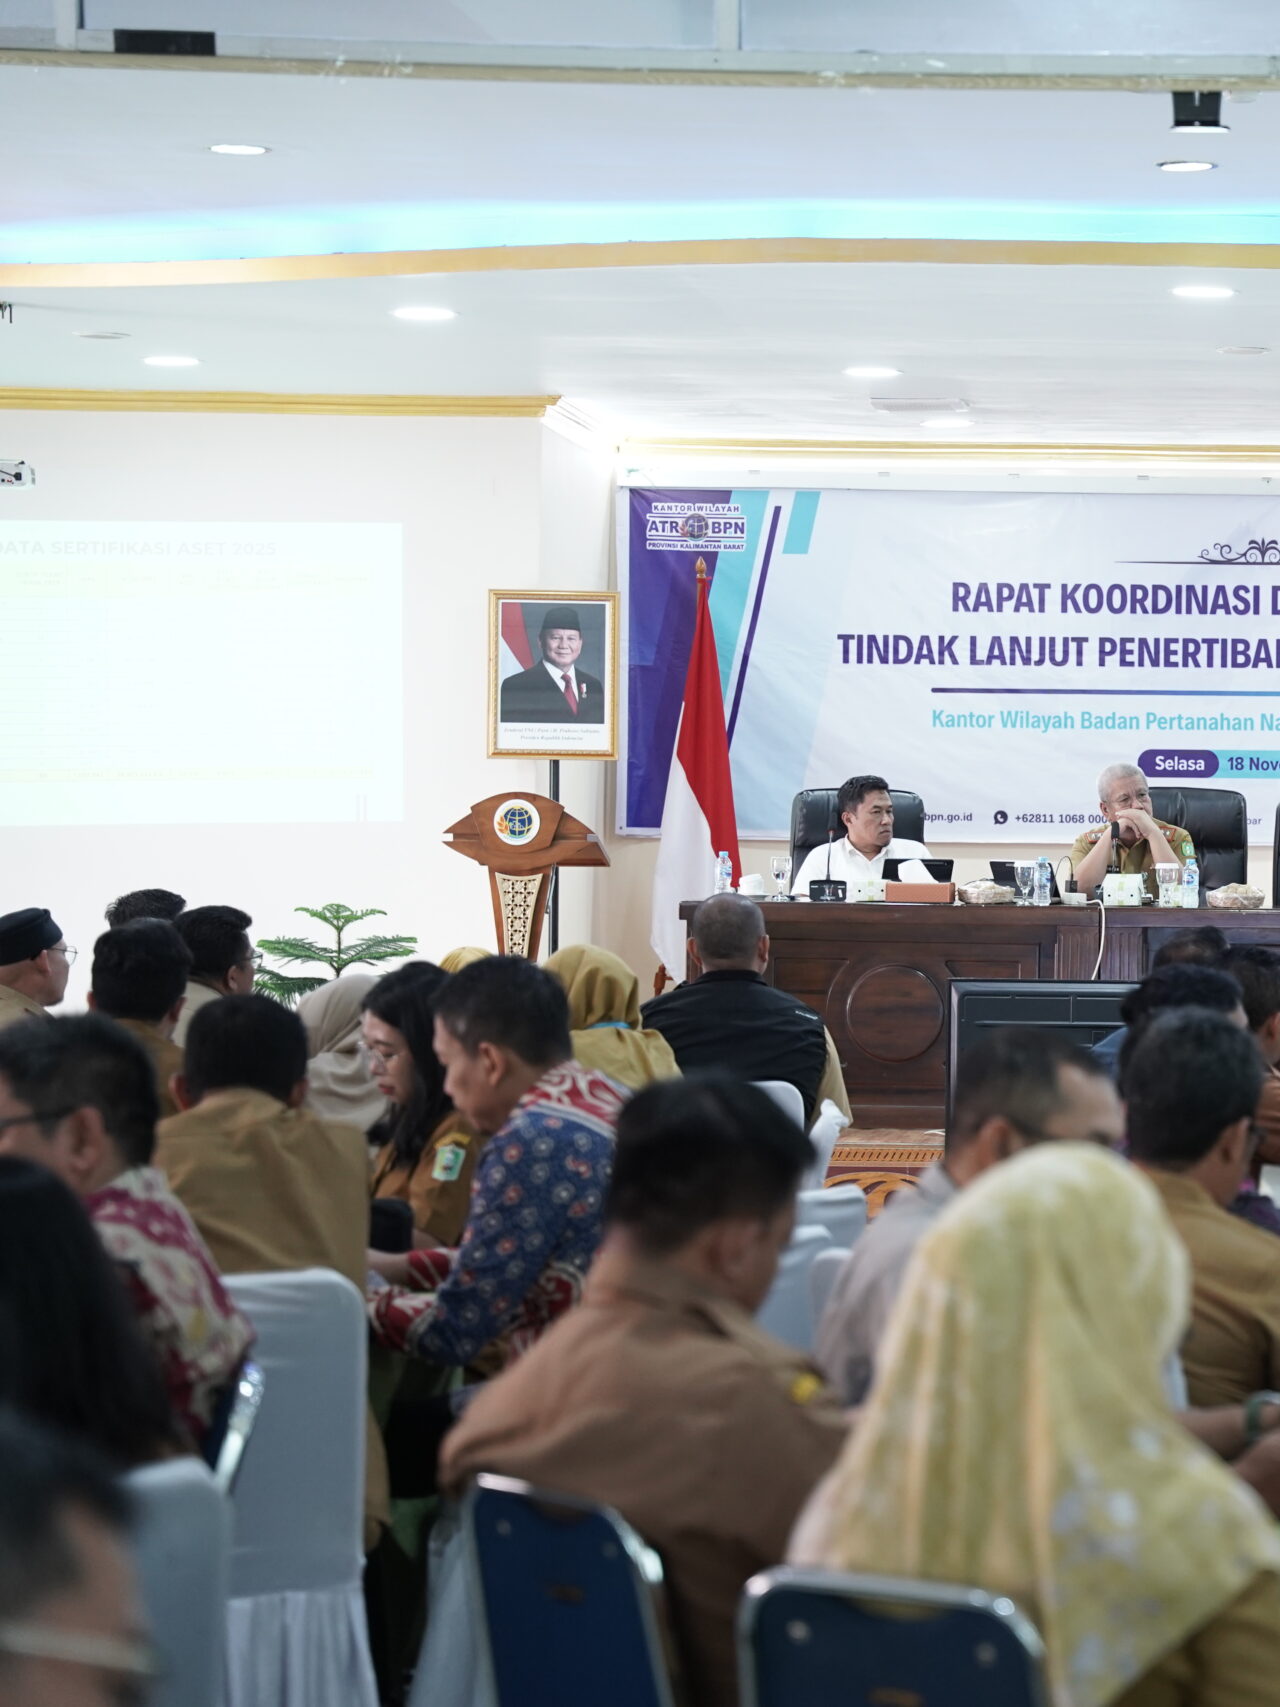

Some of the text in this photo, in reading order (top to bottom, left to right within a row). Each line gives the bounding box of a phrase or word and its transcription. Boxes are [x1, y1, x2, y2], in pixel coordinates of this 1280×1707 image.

[653, 504, 740, 512] KANTOR WILAYAH
[648, 520, 745, 534] ATR BPN
[0, 541, 276, 556] ATA SERTIFIKASI ASET 2025
[953, 582, 1051, 613] RAPAT
[1061, 584, 1260, 615] KOORDINASI
[837, 634, 959, 665] TINDAK
[970, 636, 1089, 666] LANJUT
[932, 710, 995, 728] Kantor
[1000, 711, 1074, 733] Wilayah
[1081, 711, 1140, 730] Badan
[1146, 712, 1254, 731] Pertanahan
[1155, 755, 1204, 771] Selasa
[1228, 756, 1245, 771] 18
[924, 812, 973, 825] bpn.go.id
[1015, 813, 1108, 824] +62811 1068 000
